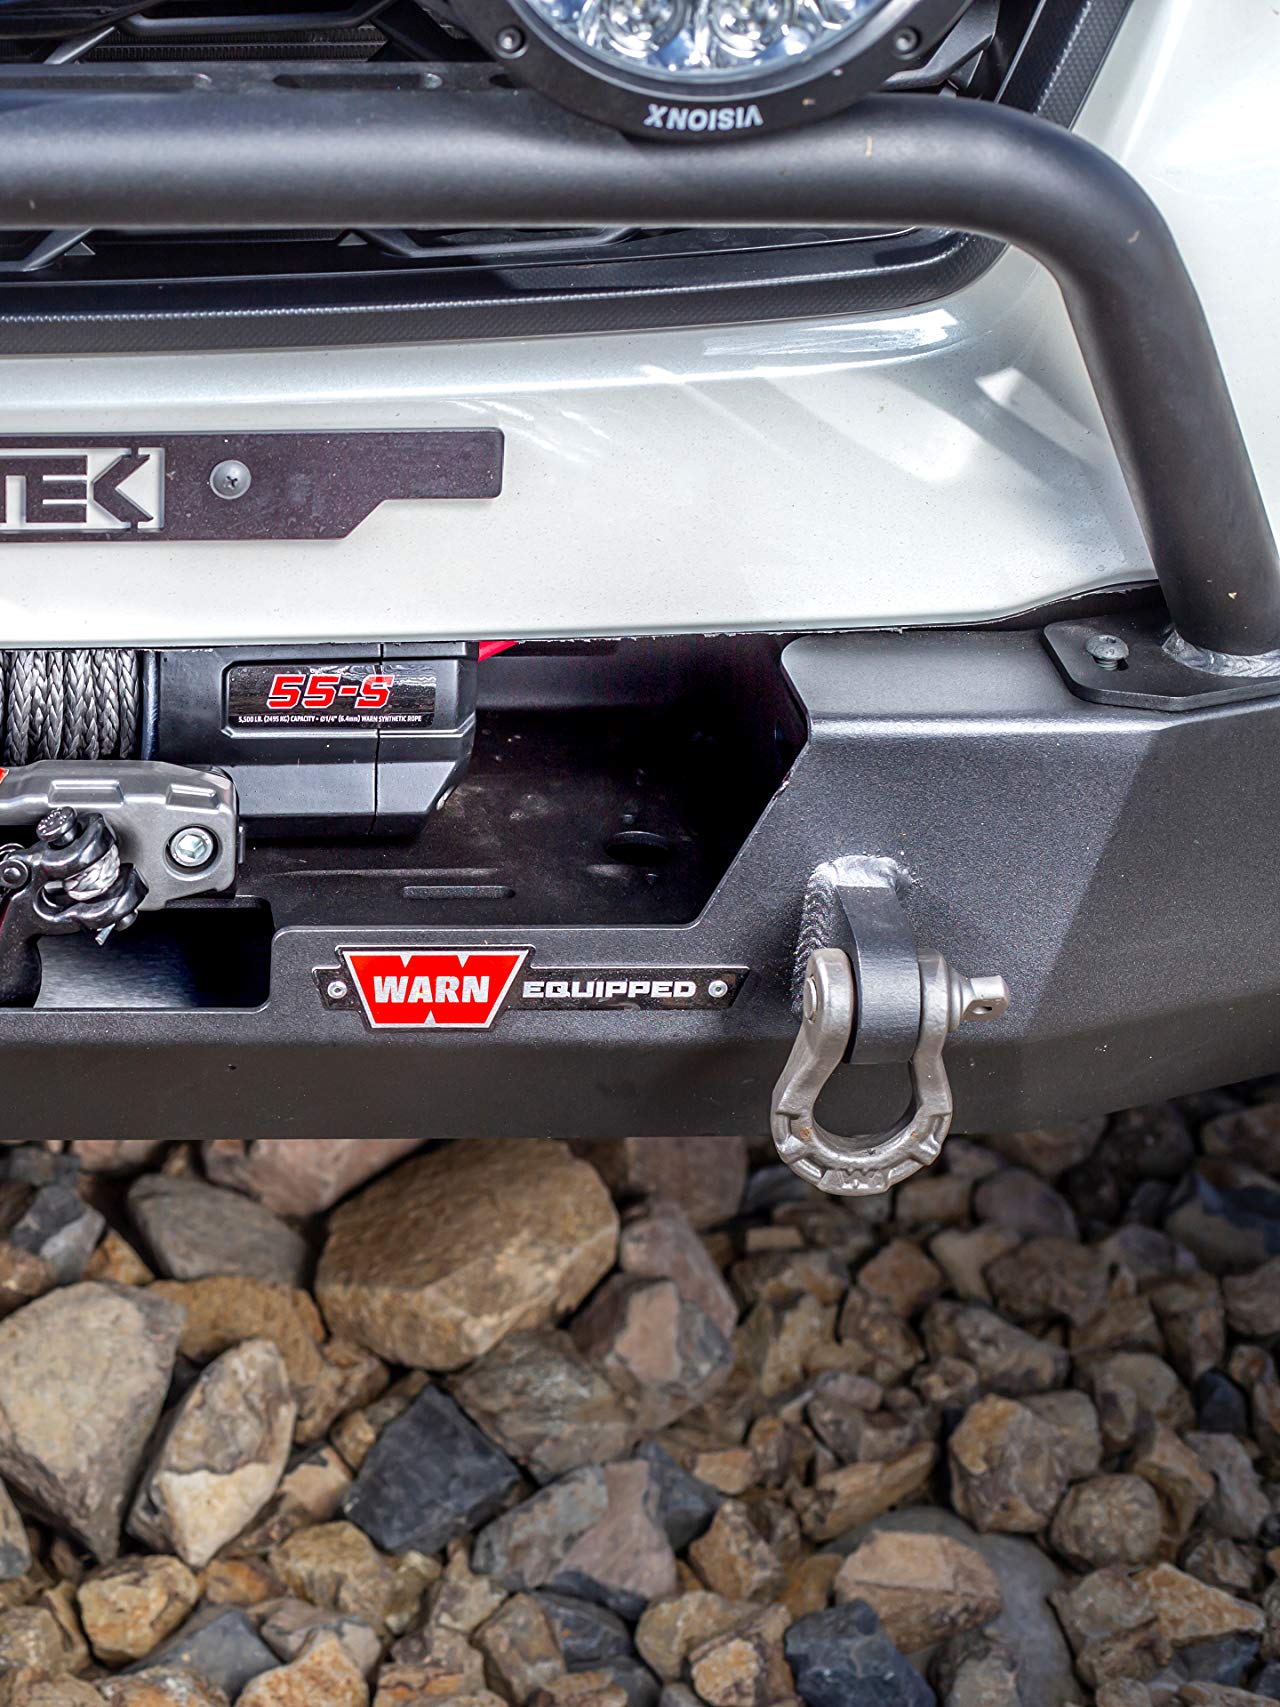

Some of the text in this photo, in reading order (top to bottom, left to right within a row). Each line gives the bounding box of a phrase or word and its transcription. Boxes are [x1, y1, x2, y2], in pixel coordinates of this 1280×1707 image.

[643, 103, 764, 132] VISIONX
[266, 673, 394, 709] 55-S
[290, 715, 316, 723] CAPACITY
[373, 975, 697, 1003] WARN EQUIPPED
